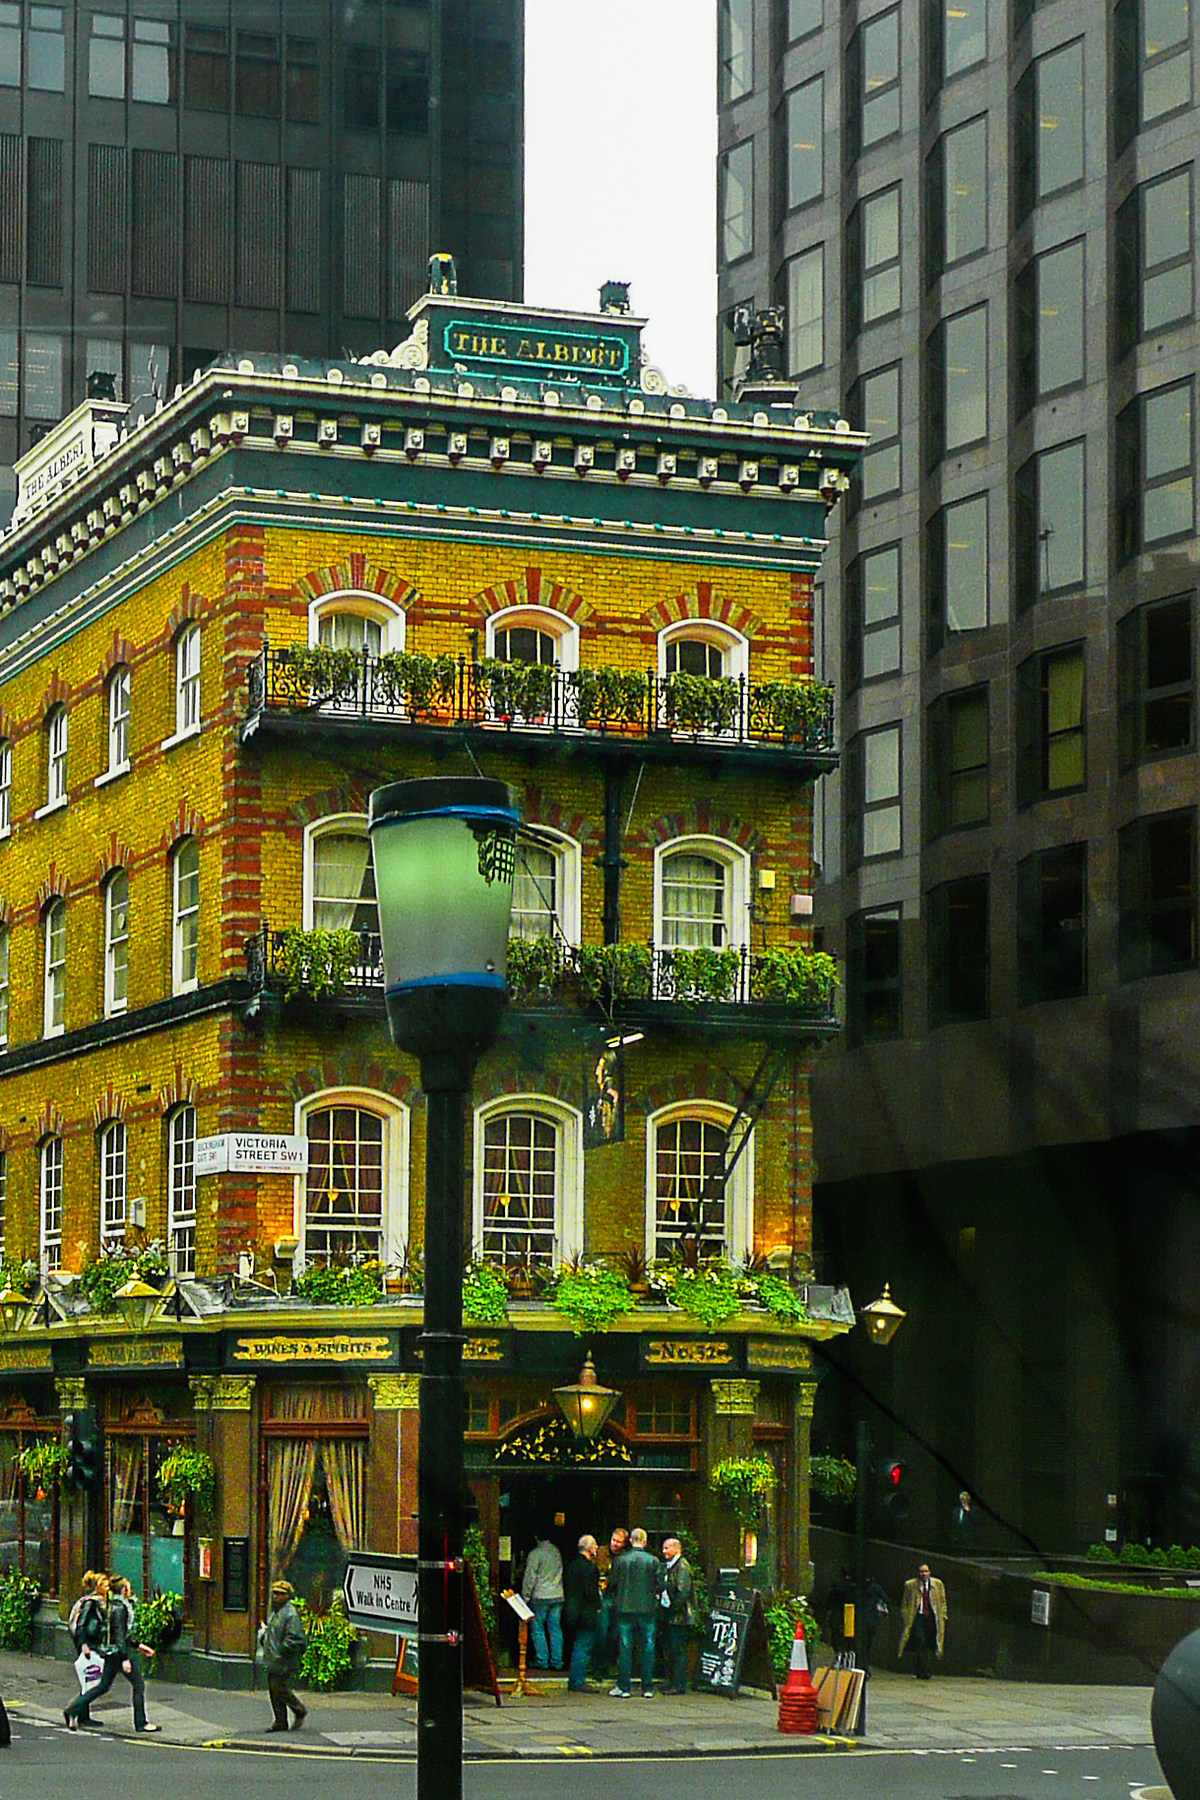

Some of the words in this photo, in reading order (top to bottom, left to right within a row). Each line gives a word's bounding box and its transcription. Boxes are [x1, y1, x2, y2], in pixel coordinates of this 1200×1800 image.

[453, 333, 507, 355] THE
[516, 339, 621, 366] ALBERT
[26, 474, 45, 500] THE
[46, 439, 84, 484] ALBERT
[235, 1138, 287, 1149] VICTORIA
[235, 1149, 277, 1160] STREET
[253, 1343, 299, 1354] WINES
[317, 1342, 372, 1355] SPIRITS
[373, 1574, 392, 1590] NHS
[356, 1590, 375, 1607] Walk
[384, 1594, 411, 1612] Centre
[712, 1621, 738, 1642] TEA
[724, 1638, 737, 1656] 2
